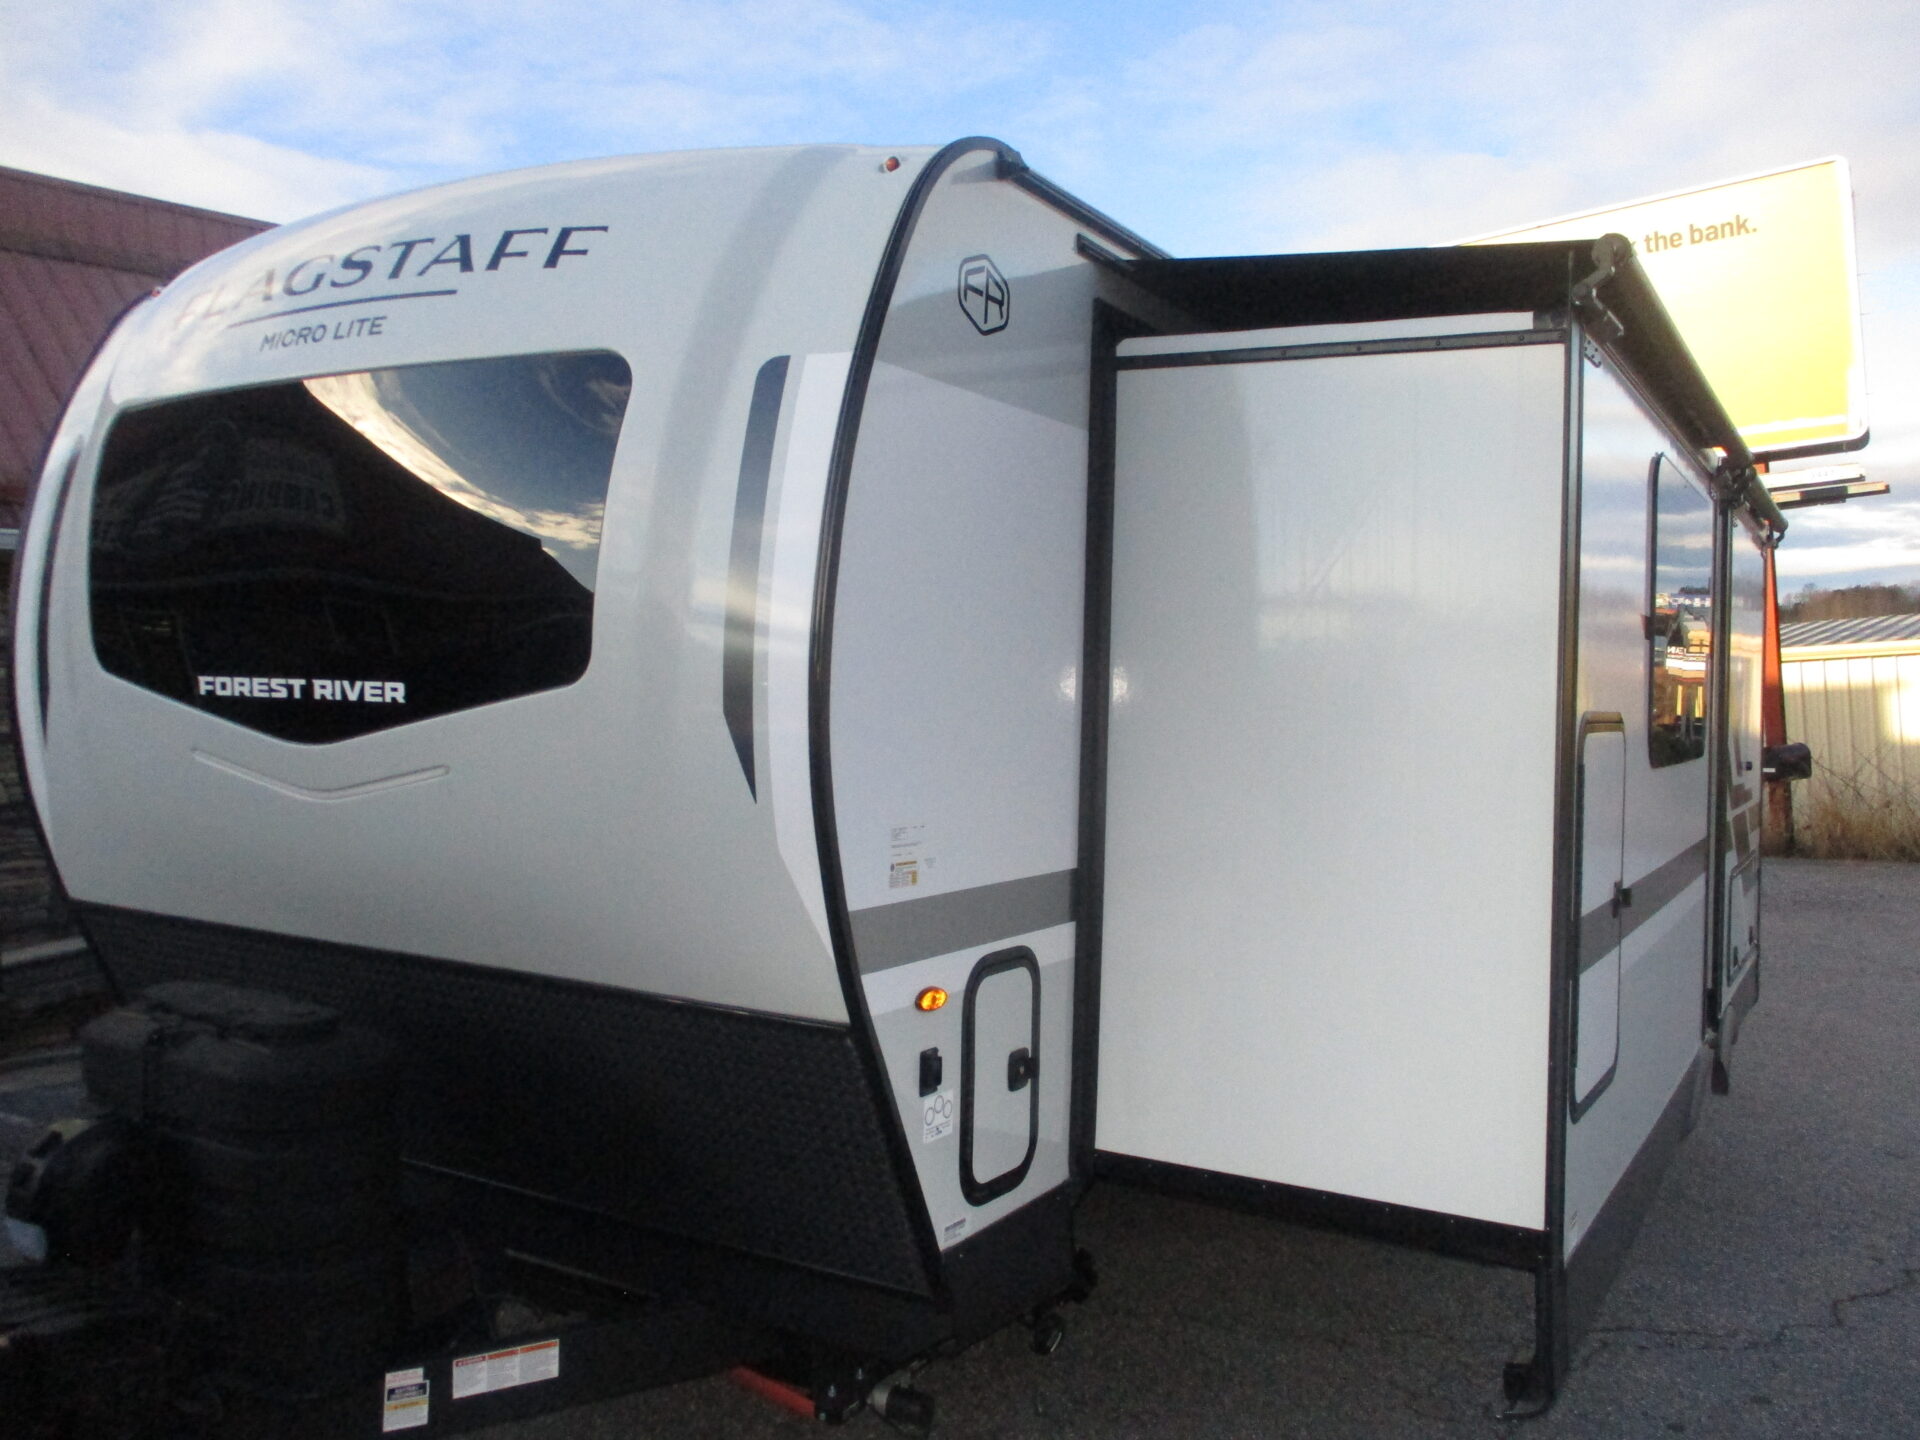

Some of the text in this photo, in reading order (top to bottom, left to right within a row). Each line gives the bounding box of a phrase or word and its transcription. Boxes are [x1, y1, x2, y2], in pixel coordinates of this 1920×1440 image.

[1644, 230, 1683, 253] the
[1688, 214, 1757, 245] bank.
[175, 225, 609, 331] FLAGSTAFF
[259, 315, 388, 352] MICRO LITE
[198, 675, 406, 703] FOREST RIVER
